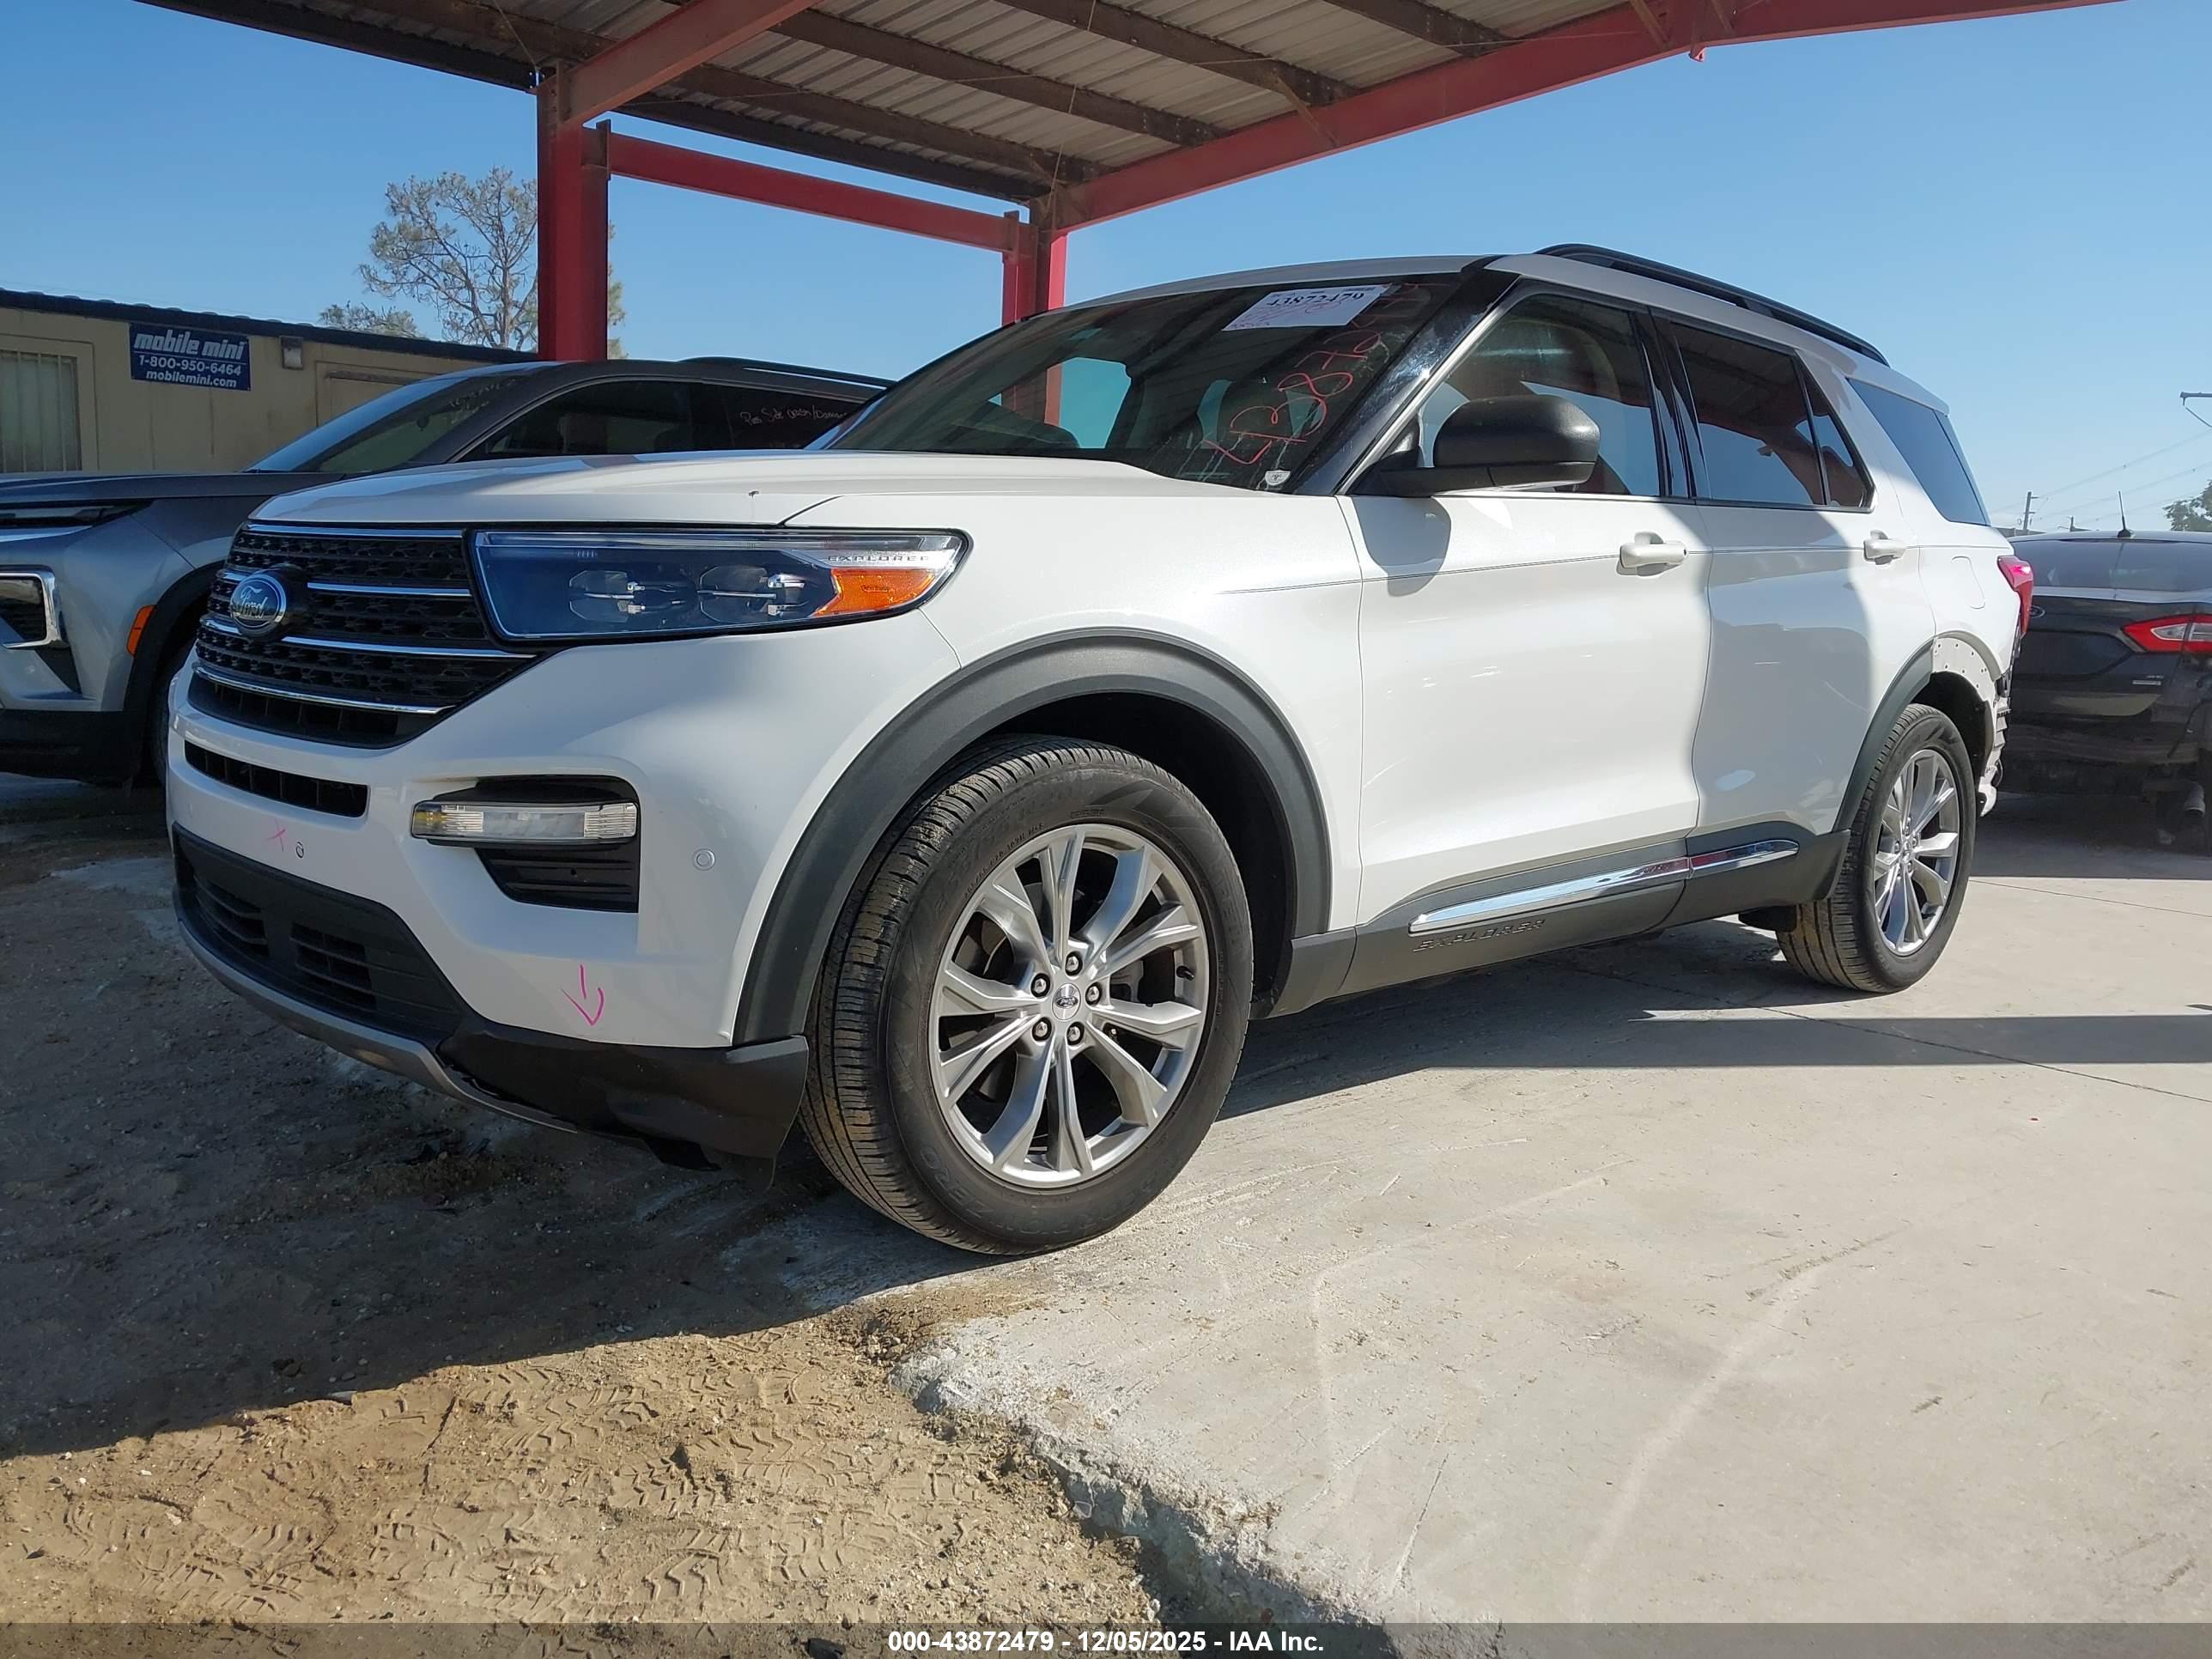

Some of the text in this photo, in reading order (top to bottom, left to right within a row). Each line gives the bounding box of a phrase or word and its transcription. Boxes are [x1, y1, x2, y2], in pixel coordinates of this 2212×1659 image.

[134, 329, 247, 360] mobile mini
[138, 355, 241, 376] 1-800-950-6464
[146, 370, 237, 388] mobilemini.com
[239, 585, 269, 619] Ford
[1412, 919, 1546, 952] EXPLORER
